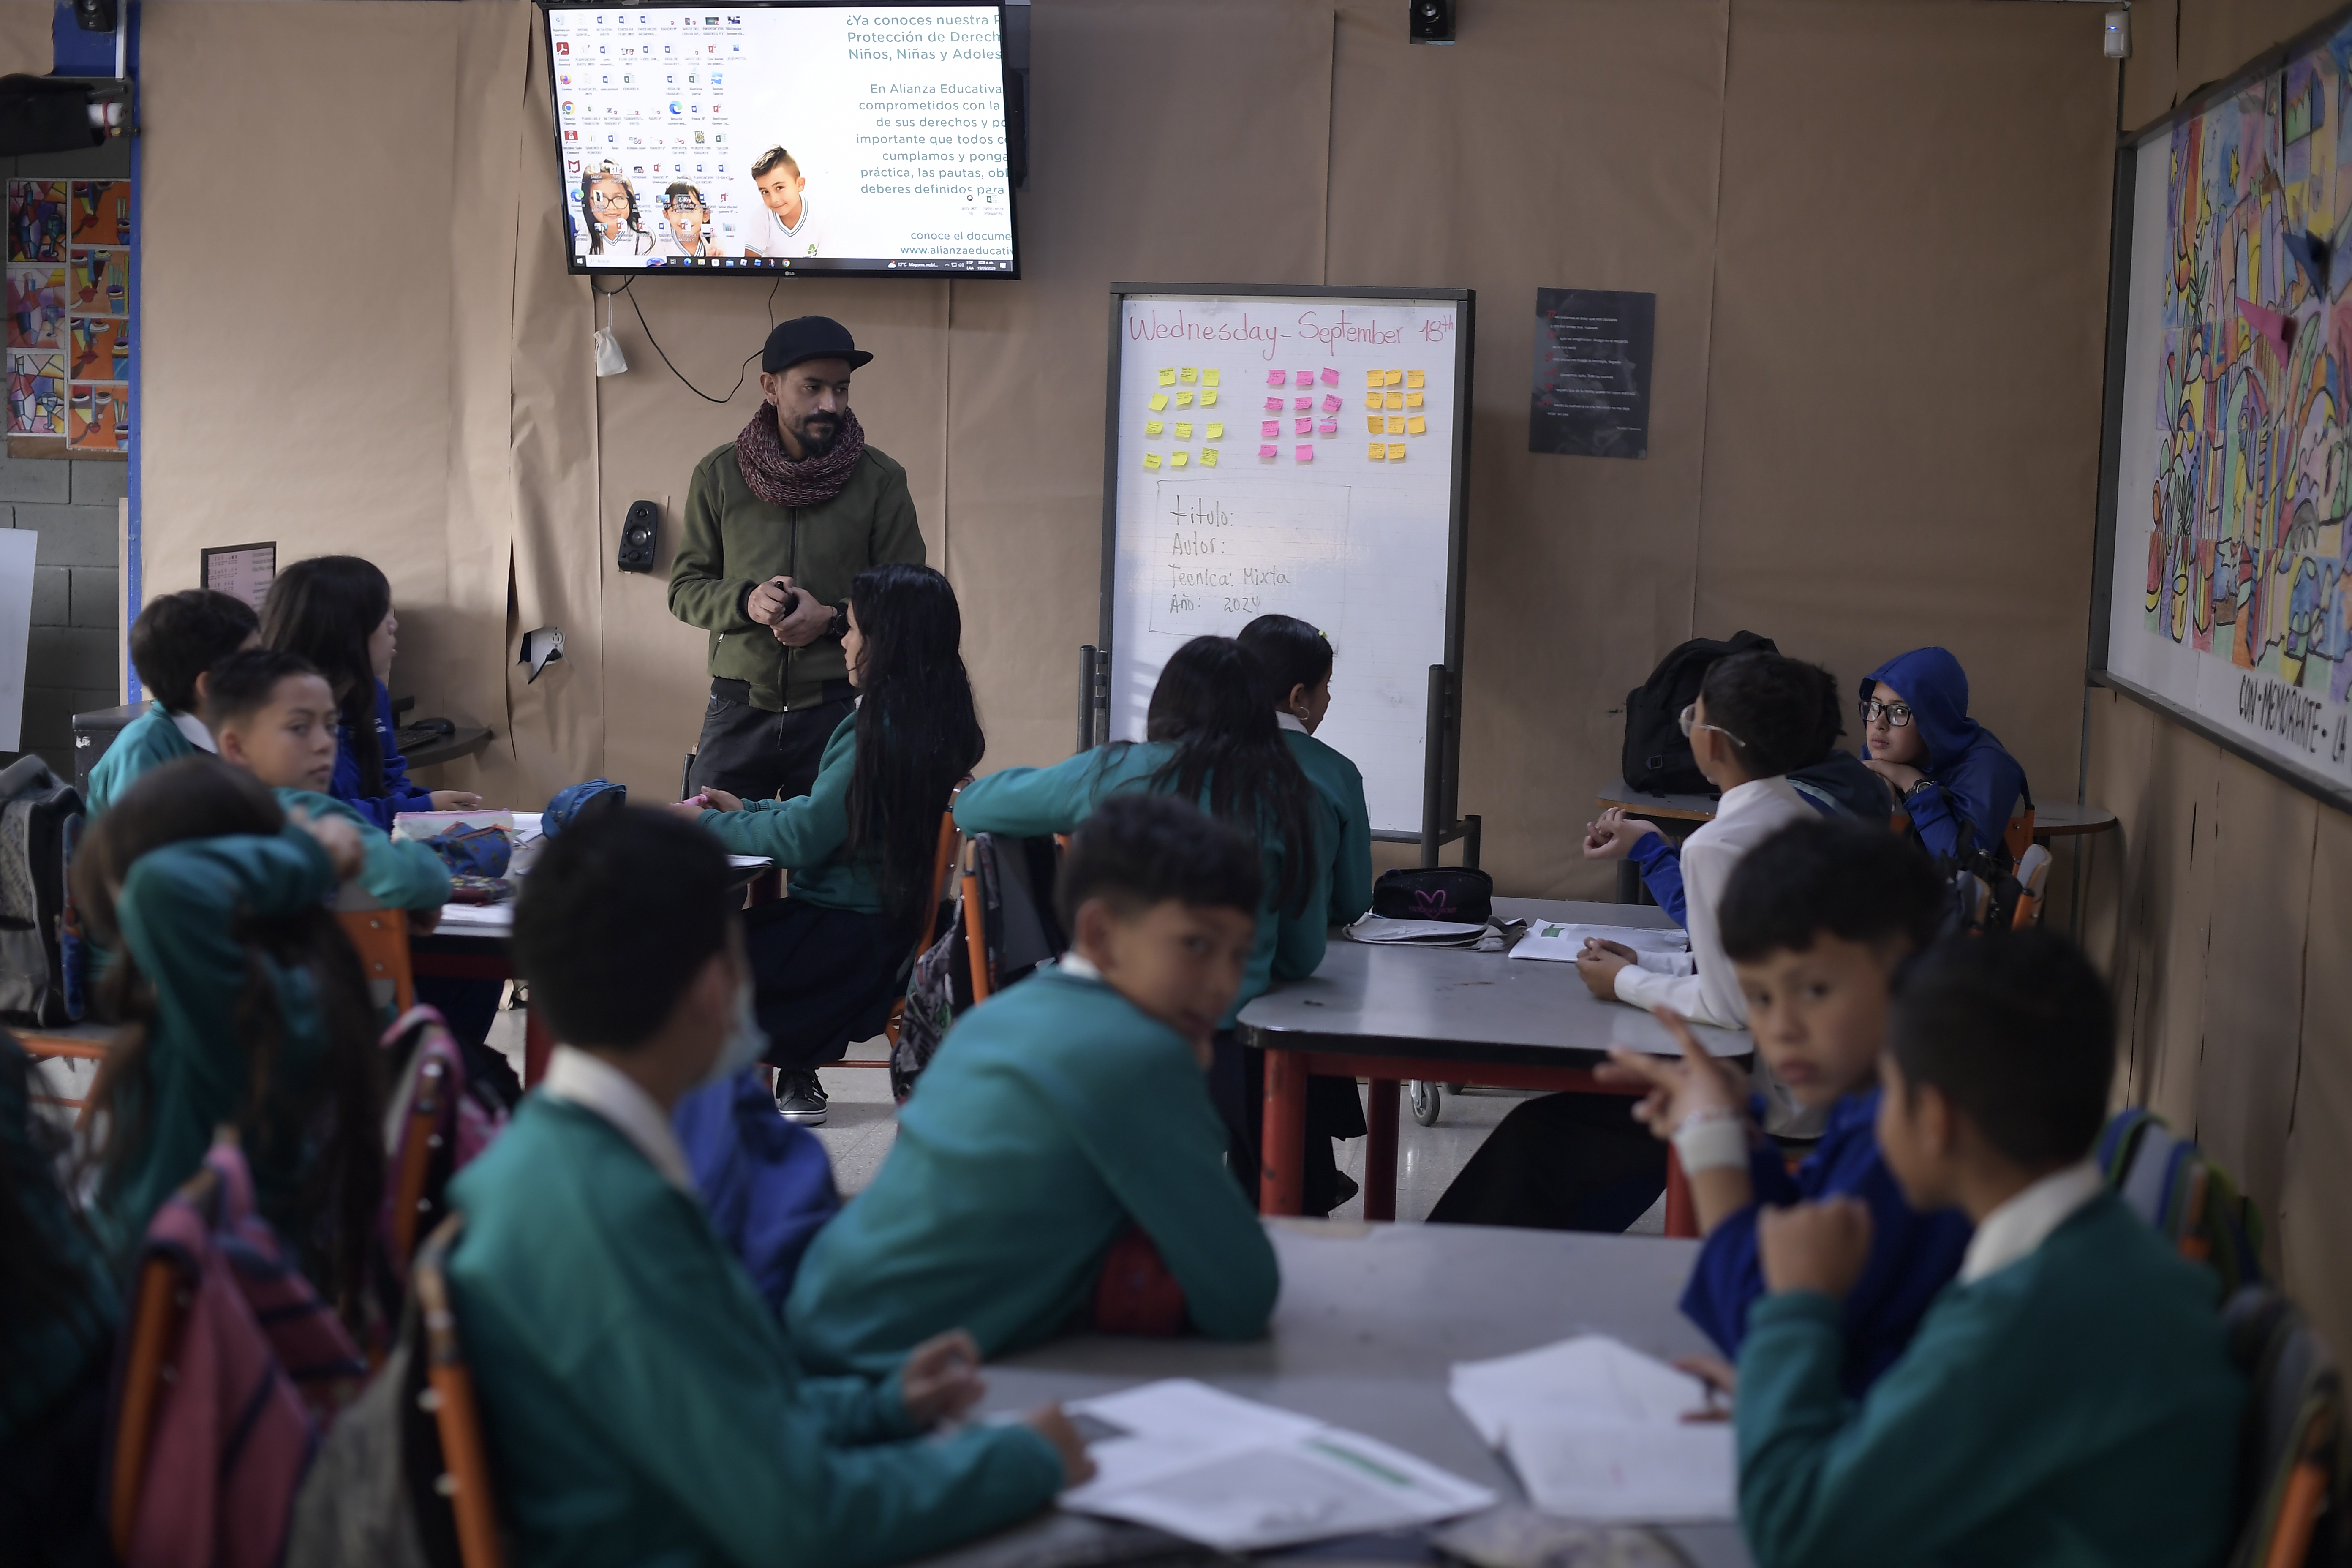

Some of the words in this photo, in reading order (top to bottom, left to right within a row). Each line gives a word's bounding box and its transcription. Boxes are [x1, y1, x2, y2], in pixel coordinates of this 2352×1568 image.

[847, 15, 868, 25] ¿Ya
[937, 16, 988, 24] nuestra
[848, 31, 922, 42] Protección
[928, 32, 945, 42] de
[951, 31, 1001, 41] Derech
[849, 49, 891, 61] Niños,
[897, 49, 935, 59] Niñas
[940, 52, 947, 61] y
[953, 49, 1002, 59] Adoles
[871, 84, 885, 93] En
[890, 84, 935, 93] Alianza
[941, 84, 1002, 93] Educativa
[860, 101, 958, 112] comprometidos
[990, 101, 999, 110] la
[877, 117, 890, 126] de
[920, 117, 977, 127] derechos
[982, 120, 987, 128] y
[857, 134, 925, 145] importante
[930, 137, 952, 145] que
[958, 135, 993, 144] todos
[883, 151, 954, 162] cumplamos
[959, 154, 964, 162] y
[861, 167, 913, 178] práctica,
[918, 168, 934, 177] las
[939, 169, 983, 179] pautas,
[861, 184, 910, 193] deberes
[915, 184, 972, 194] definidos
[977, 187, 1004, 196] para
[967, 232, 1011, 240] docume
[1243, 564, 1290, 585] Mixta
